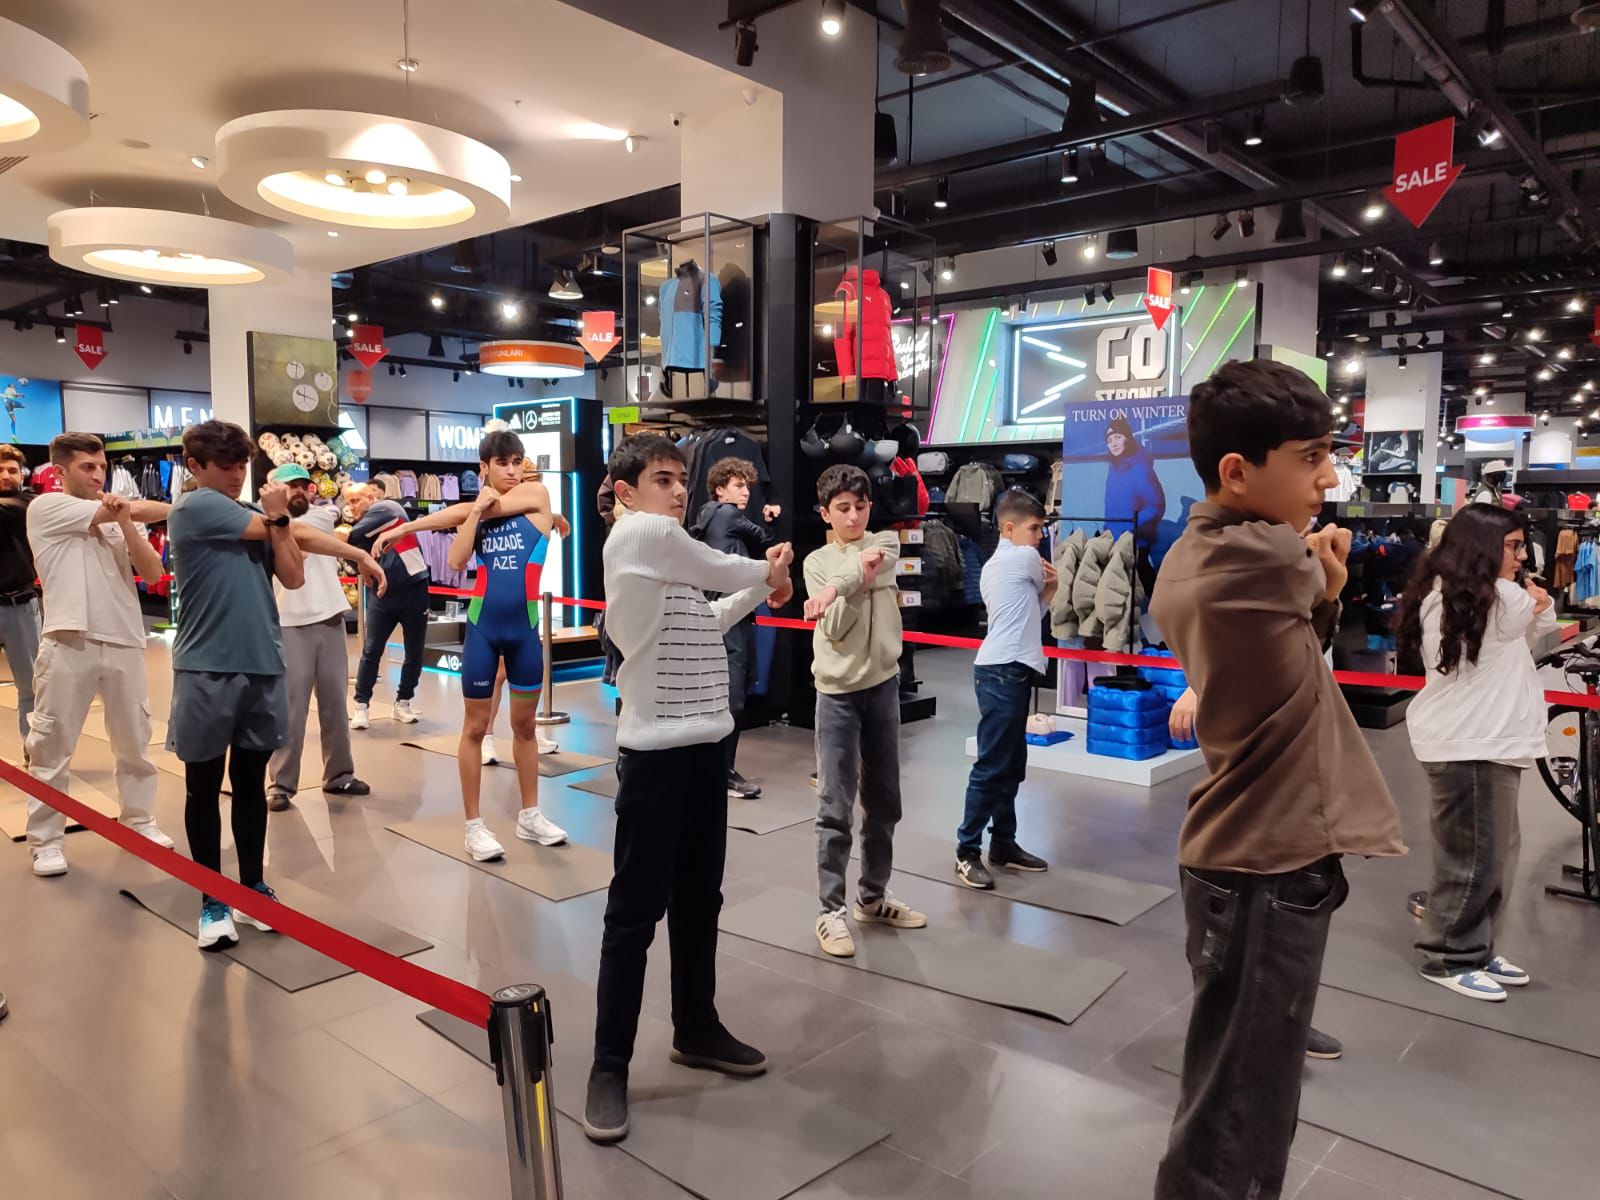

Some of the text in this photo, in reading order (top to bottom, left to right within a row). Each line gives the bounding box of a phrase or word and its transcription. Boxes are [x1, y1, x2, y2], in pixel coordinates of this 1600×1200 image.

[1395, 161, 1448, 193] SALE
[1149, 293, 1171, 310] SALE
[78, 343, 103, 355] SALE
[353, 342, 382, 354] SALE
[1096, 323, 1168, 383] GO
[1072, 404, 1185, 422] TURN ON WINTER
[437, 424, 485, 450] WOM
[492, 555, 519, 571] AZE
